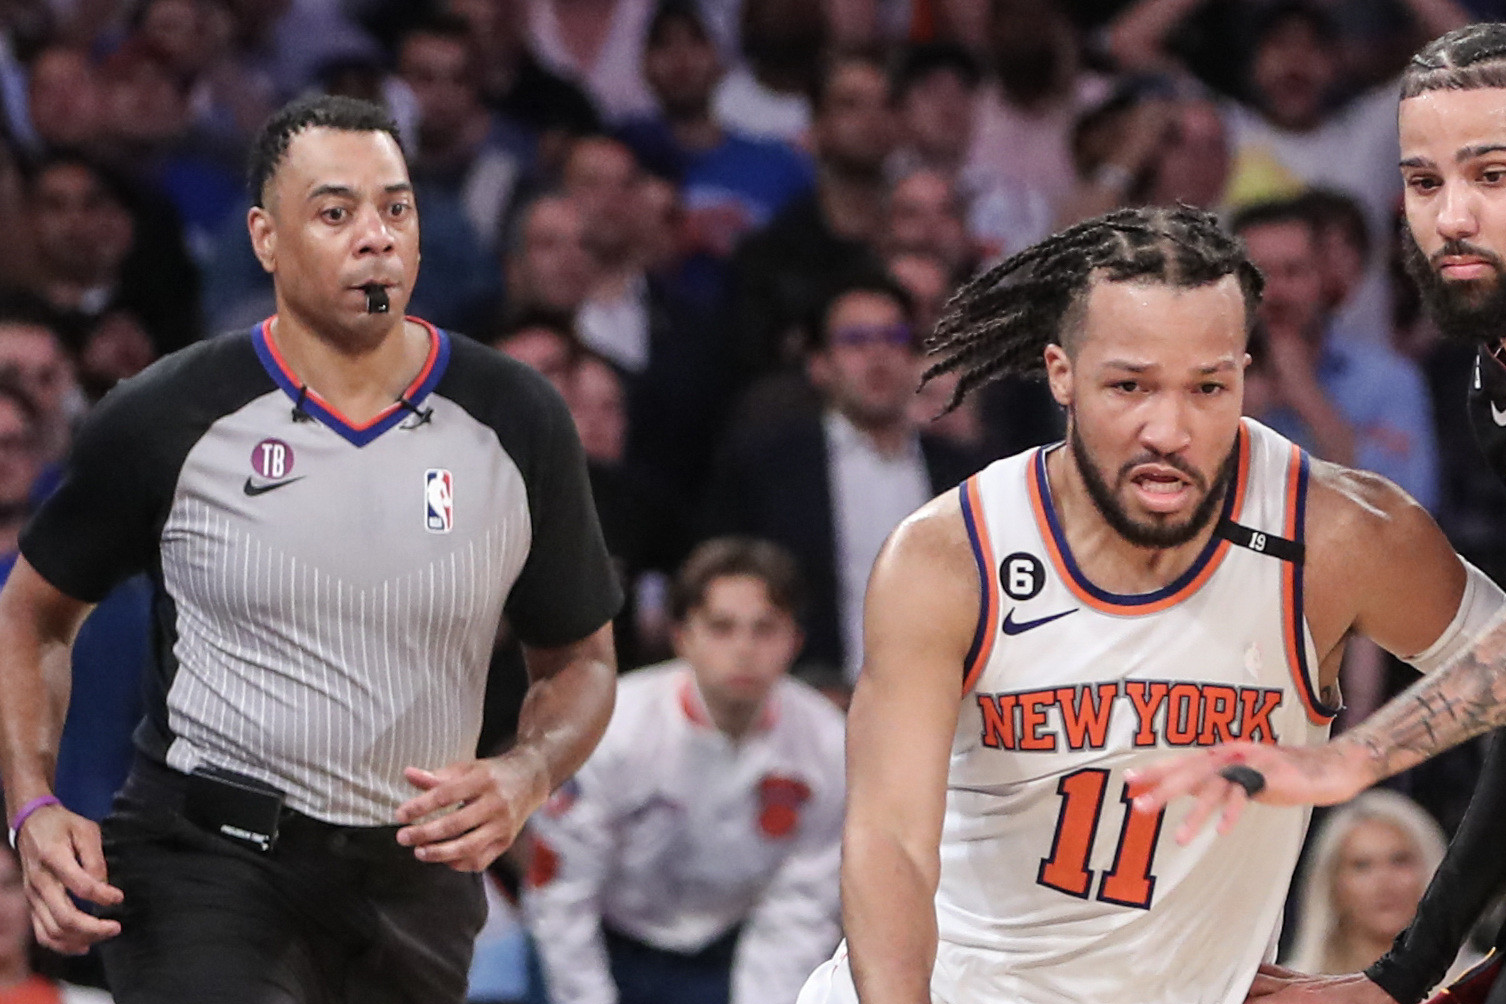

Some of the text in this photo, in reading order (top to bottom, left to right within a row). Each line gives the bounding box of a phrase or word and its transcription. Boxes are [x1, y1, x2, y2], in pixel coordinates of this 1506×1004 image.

[261, 443, 286, 478] TB
[1248, 531, 1267, 552] 19
[1009, 559, 1034, 595] 6
[977, 679, 1284, 752] NEW YORK
[1036, 767, 1167, 911] 11
